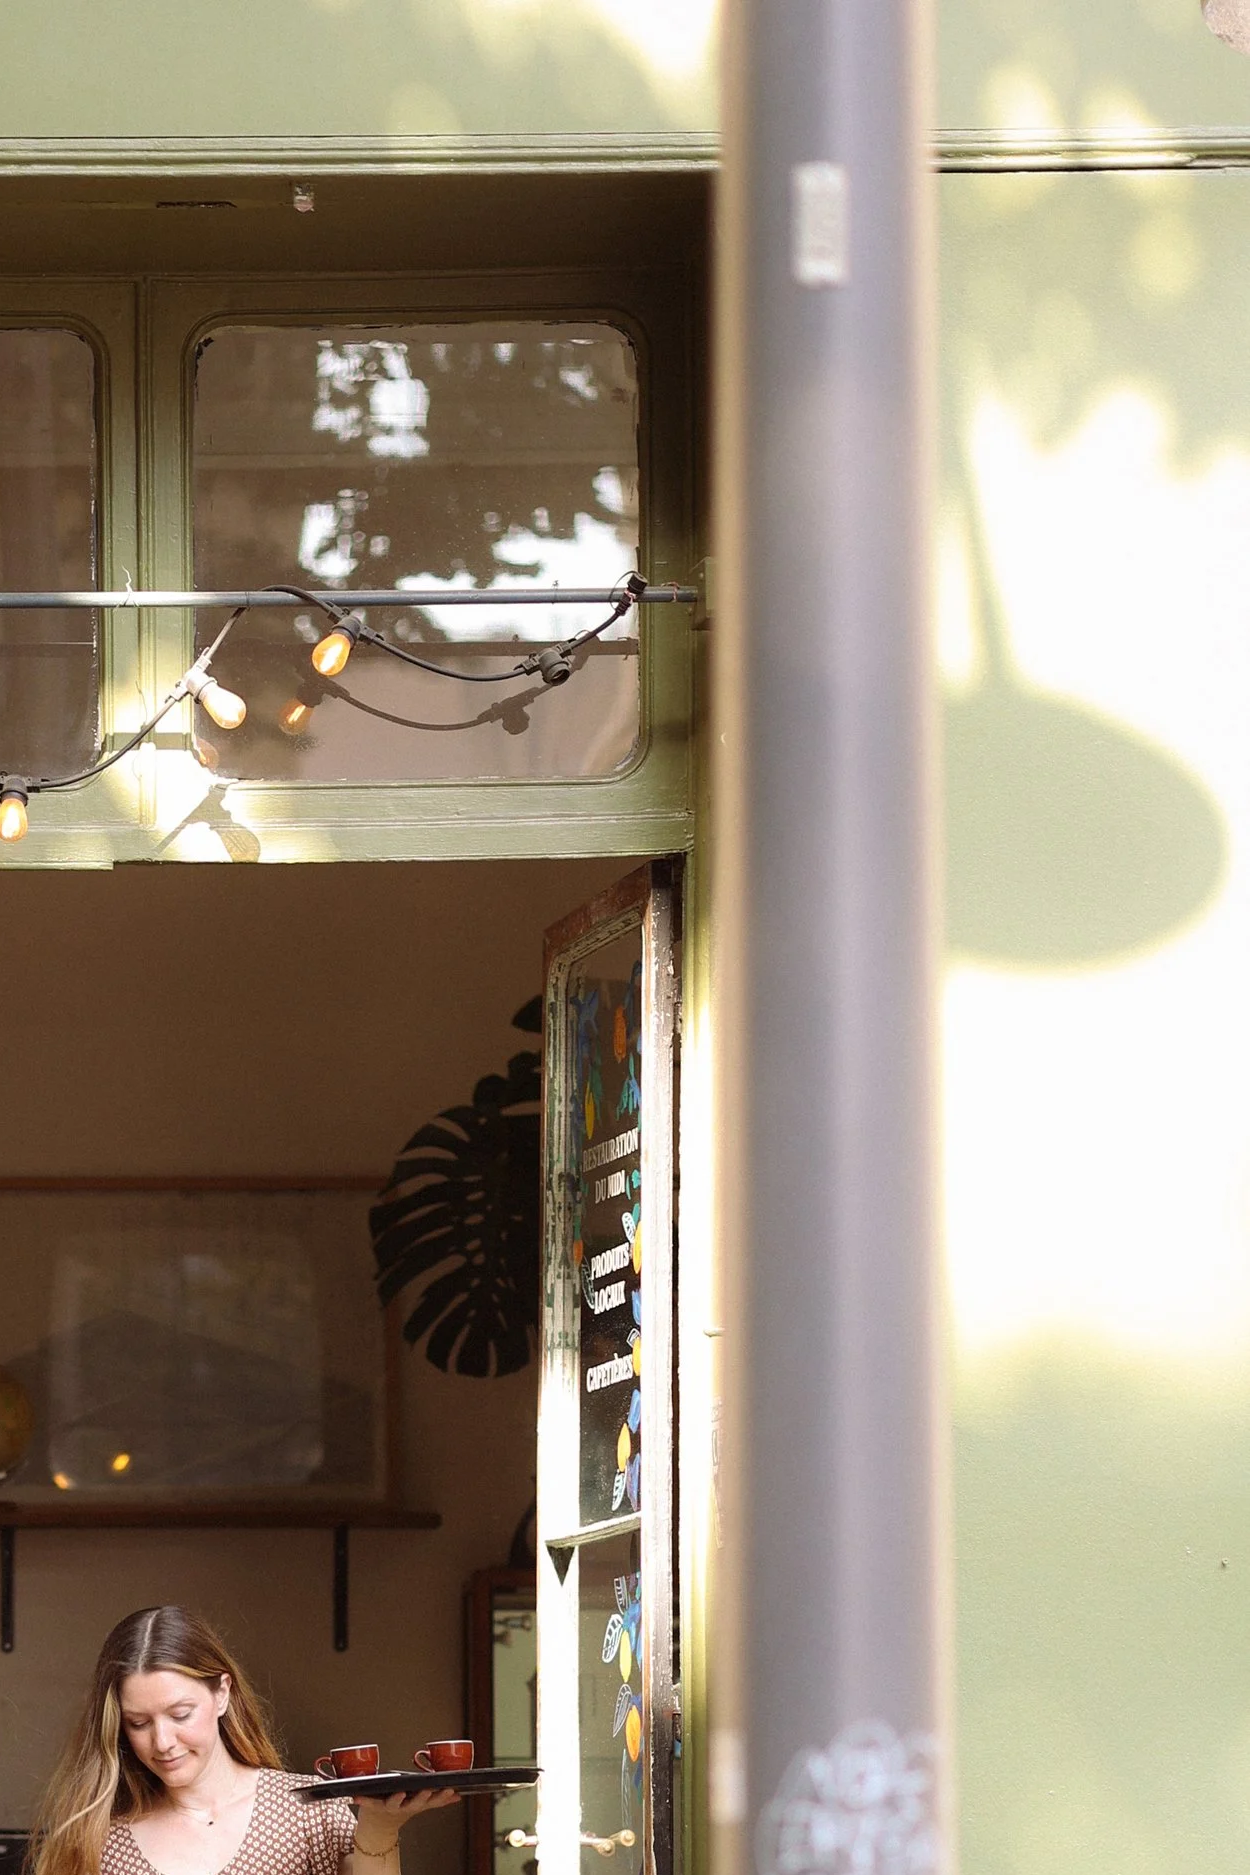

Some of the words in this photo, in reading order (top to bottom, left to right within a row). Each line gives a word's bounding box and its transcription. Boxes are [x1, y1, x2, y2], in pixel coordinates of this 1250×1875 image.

[583, 1127, 639, 1173] RESTAURATION
[595, 1178, 606, 1204] DU
[607, 1169, 625, 1199] MIDI
[591, 1242, 630, 1280] PRODUITS
[594, 1280, 626, 1315] LOCAUX
[586, 1353, 634, 1393] CAFETIÈRES
